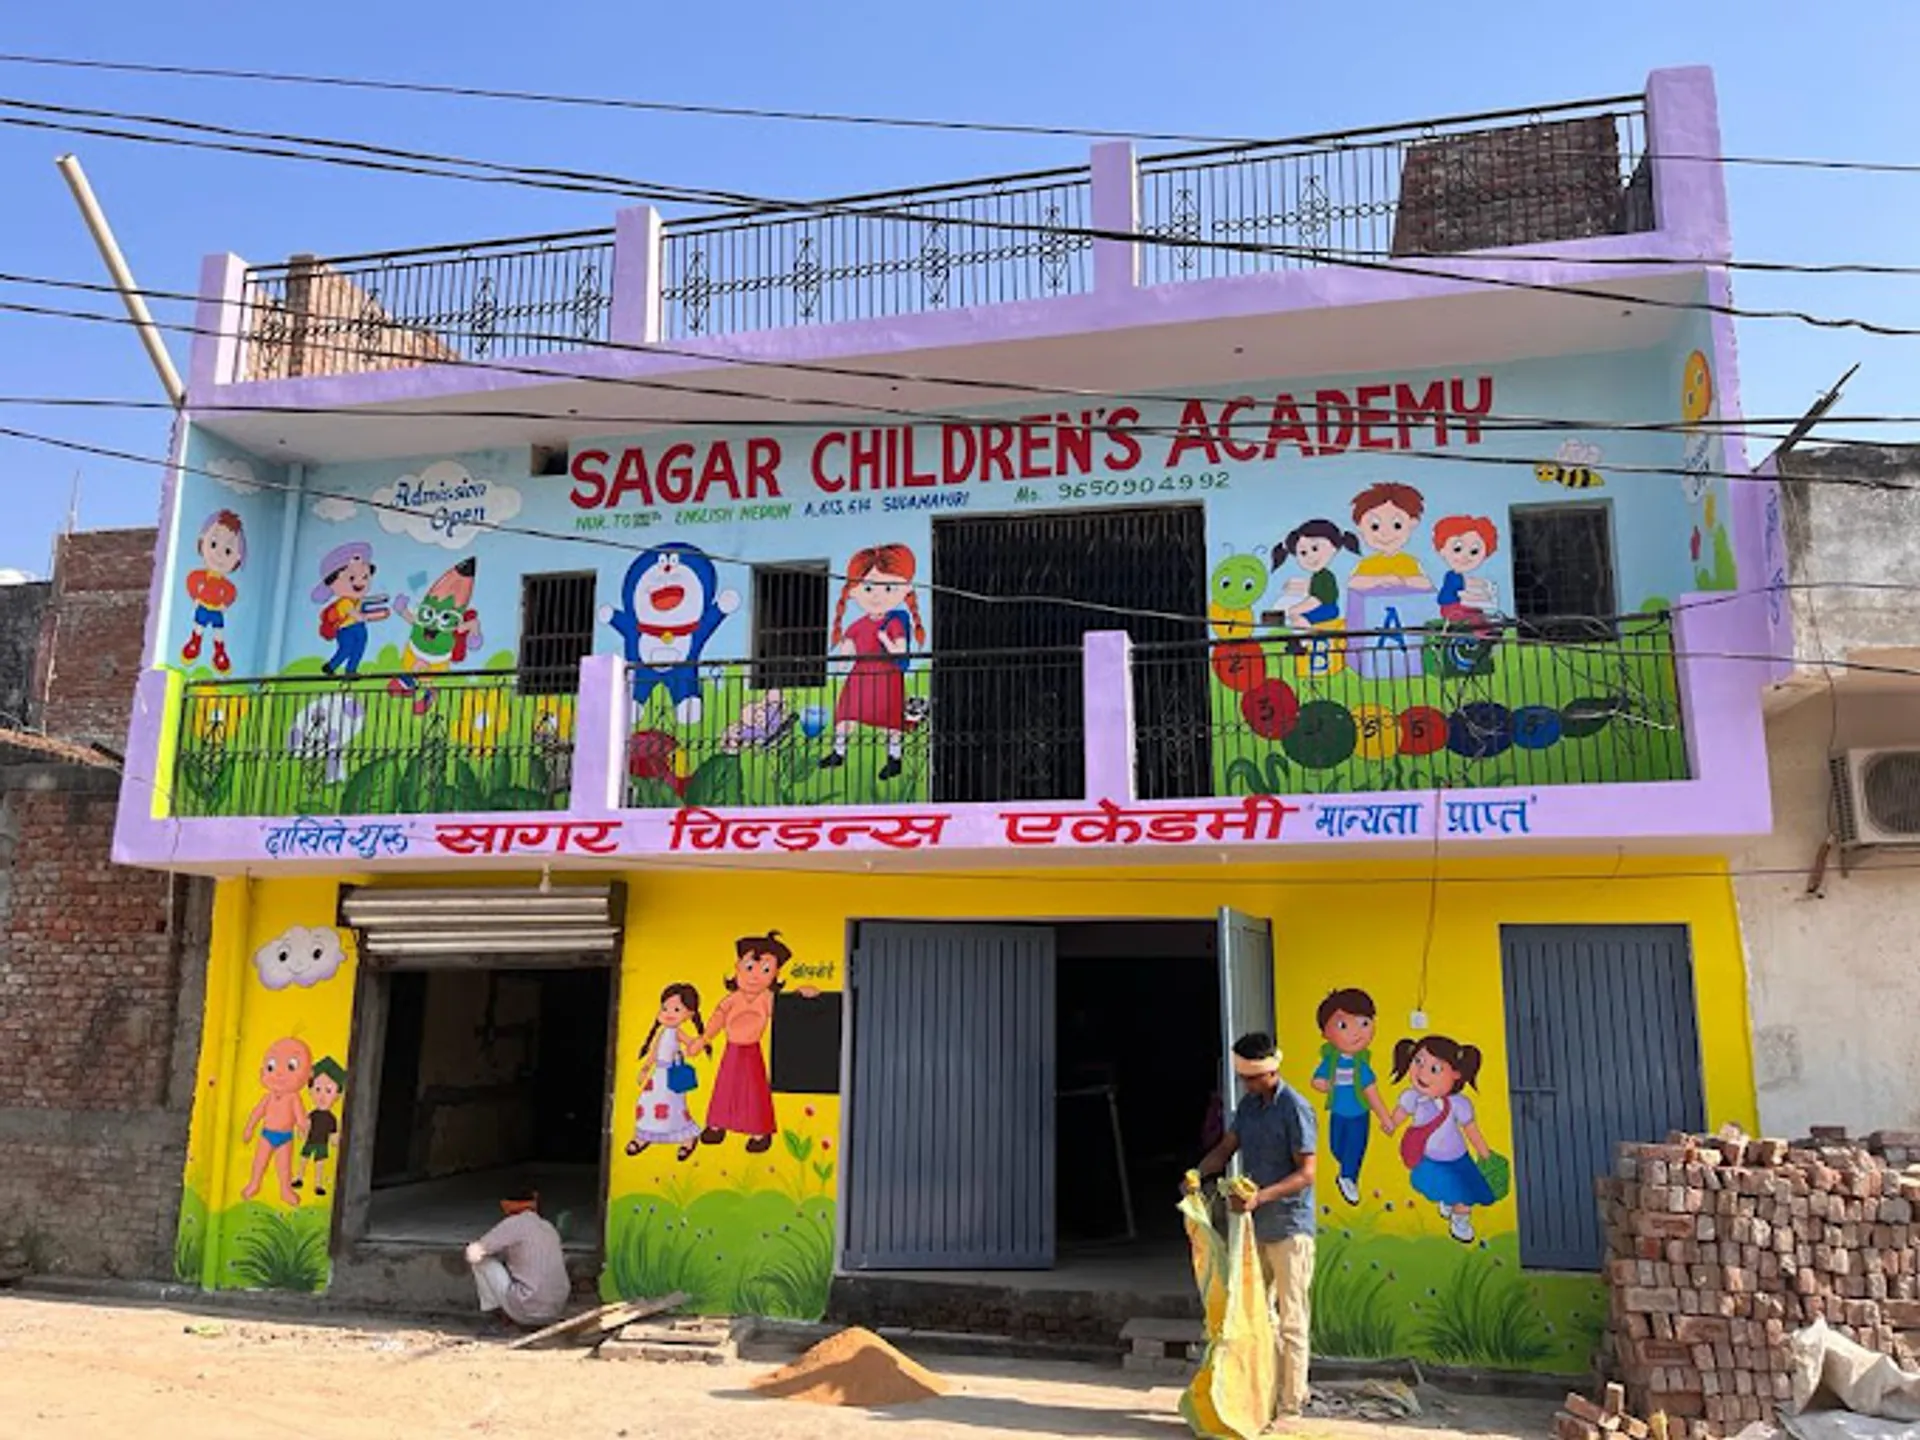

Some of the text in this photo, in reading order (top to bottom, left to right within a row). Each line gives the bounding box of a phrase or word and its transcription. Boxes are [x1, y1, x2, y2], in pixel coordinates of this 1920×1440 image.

[570, 377, 1493, 510] SAGAR CHILDREN'S ACADEMY
[431, 505, 485, 537] Open
[675, 507, 733, 526] ENGLISH
[1377, 607, 1407, 653] A
[1310, 636, 1330, 672] B
[435, 821, 622, 854] सागर
[999, 794, 1299, 843] एकेडमी
